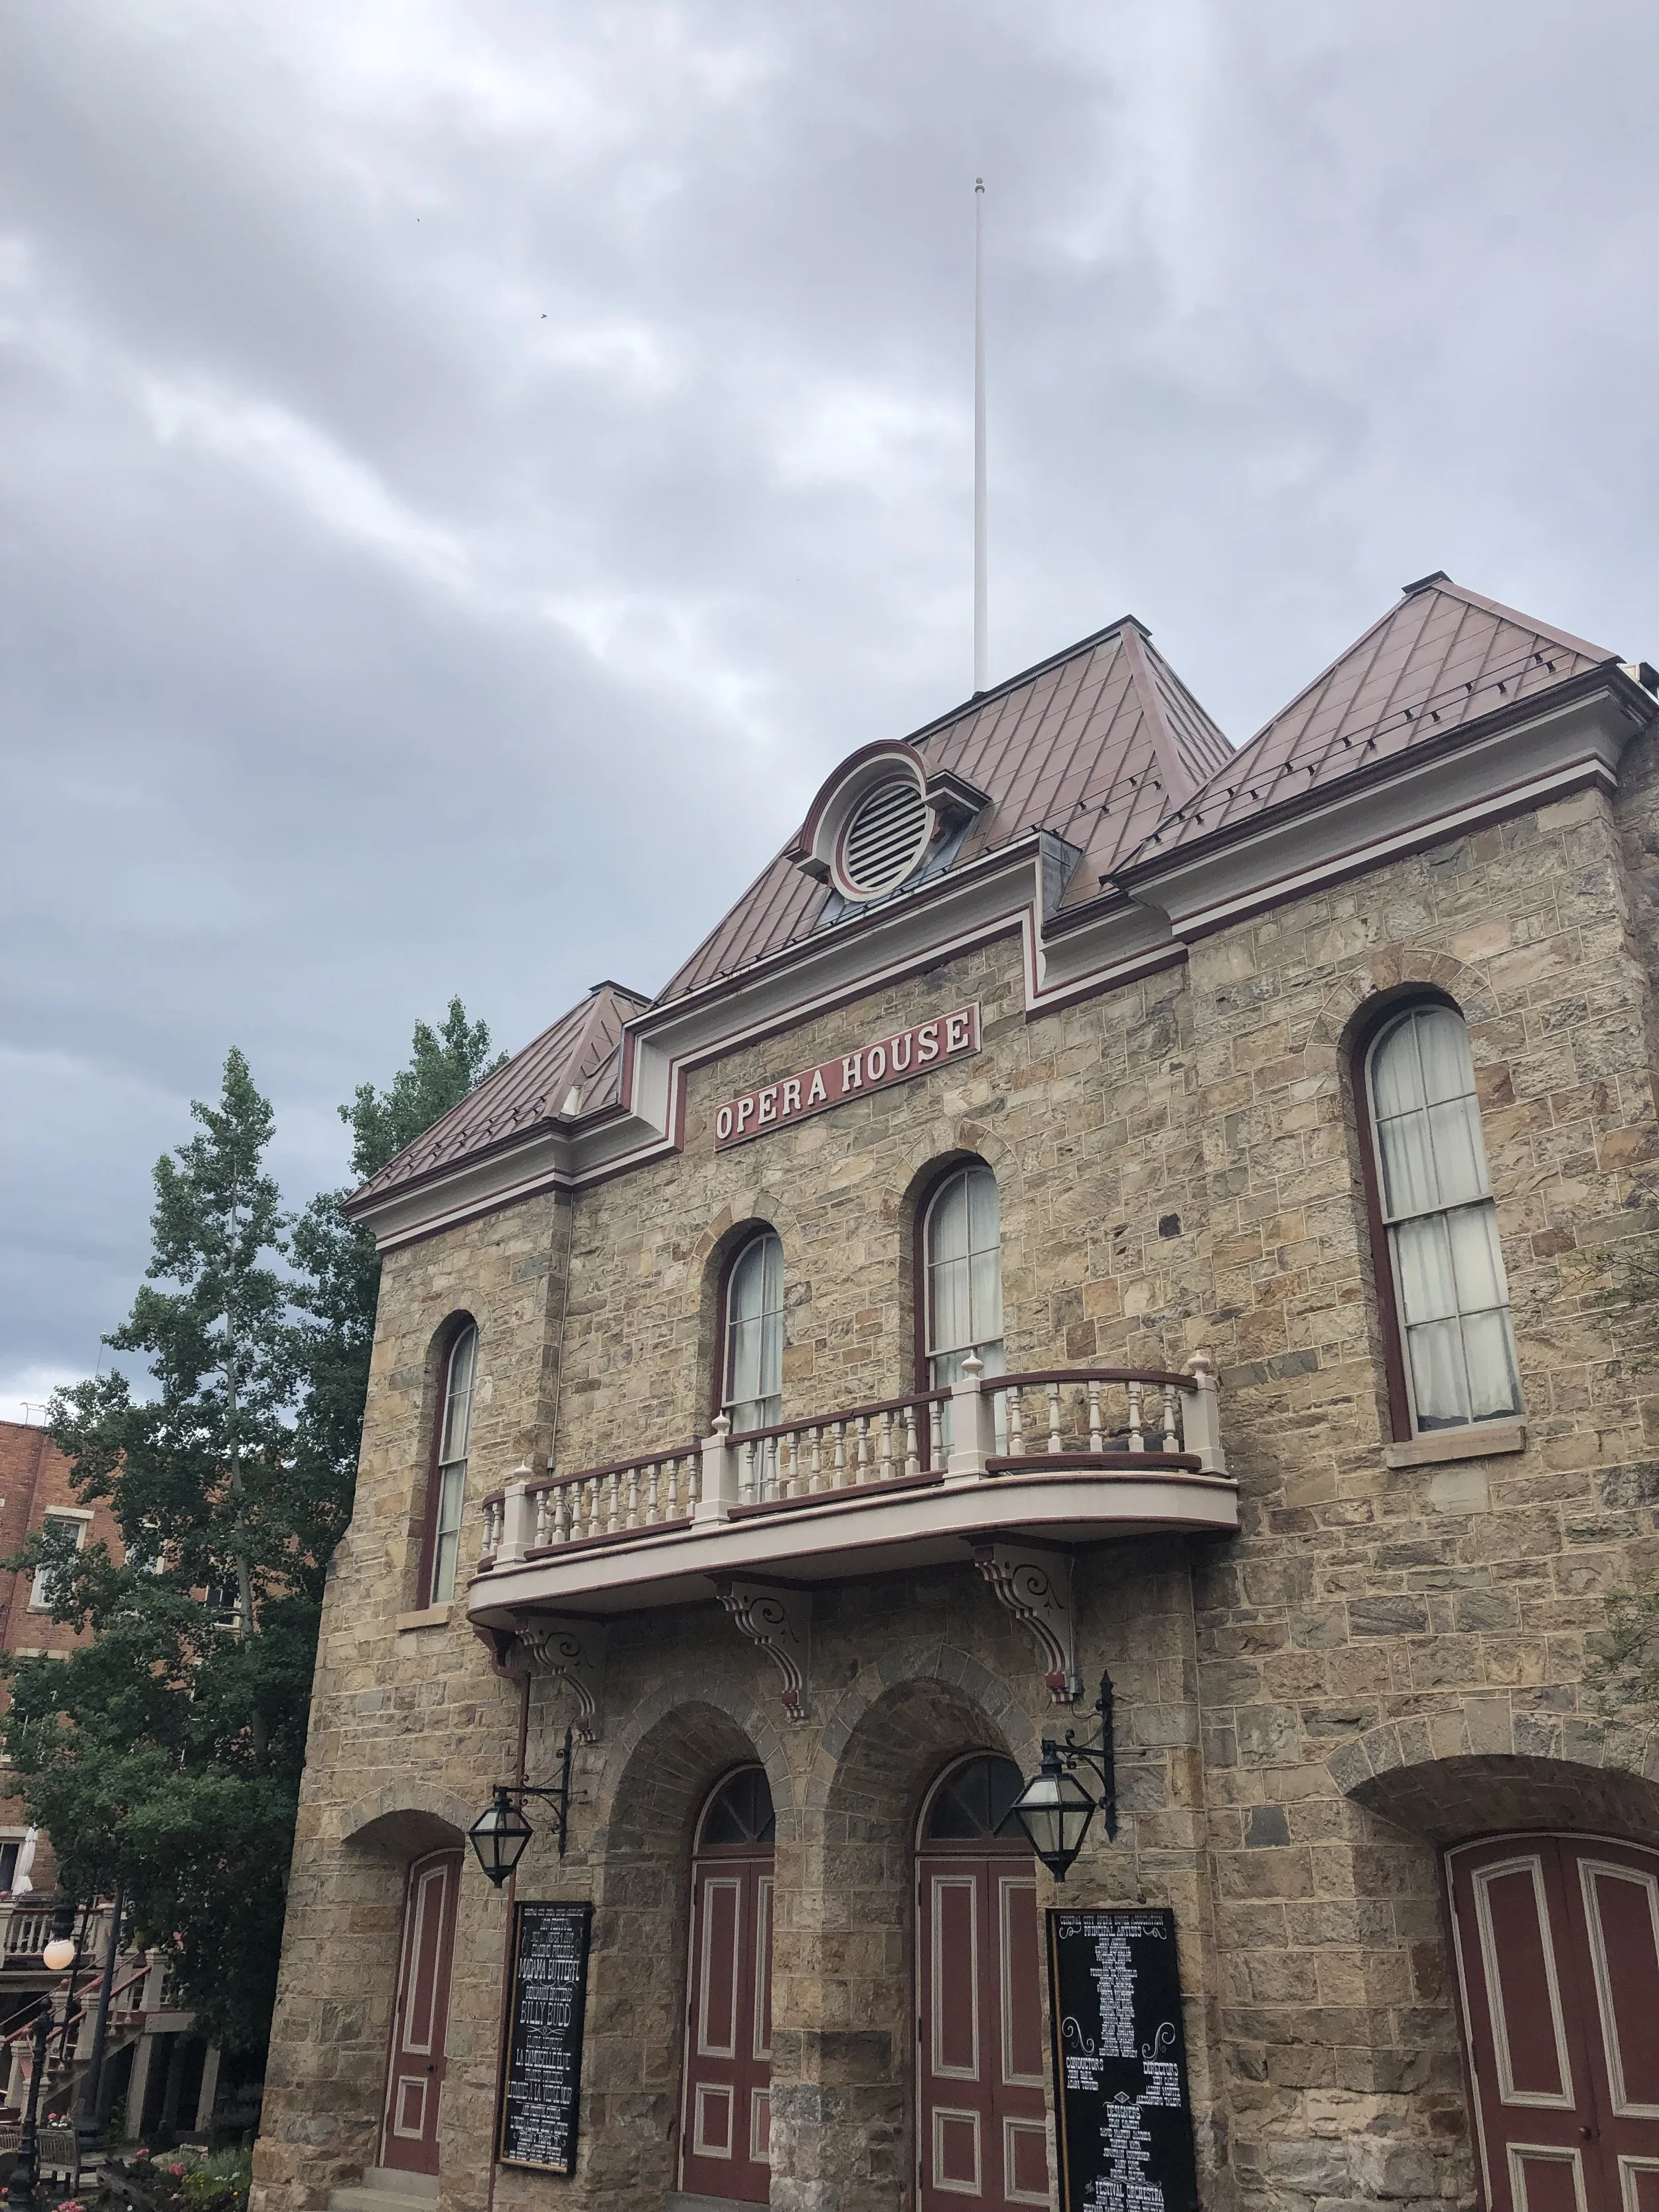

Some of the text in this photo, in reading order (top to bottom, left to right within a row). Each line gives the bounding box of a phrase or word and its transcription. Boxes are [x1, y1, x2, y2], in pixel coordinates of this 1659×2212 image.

[716, 1011, 970, 1140] OPERA HOUSE
[1083, 1915, 1094, 1925] CITY
[1097, 1915, 1112, 1925] OPERA
[1084, 1925, 1141, 1937] PRINCIPAL ARTISTS
[518, 1958, 581, 1981] MADAMA BUTTERFL
[520, 2000, 571, 2027] BILLY BUDD
[1066, 2057, 1104, 2071] CONDUCTORS
[1143, 2061, 1179, 2077] DIRECTORS
[1106, 2104, 1141, 2120] DESIGNERS
[1095, 2181, 1125, 2197] FESTIVAL
[1126, 2185, 1165, 2203] ORCHESTRA
